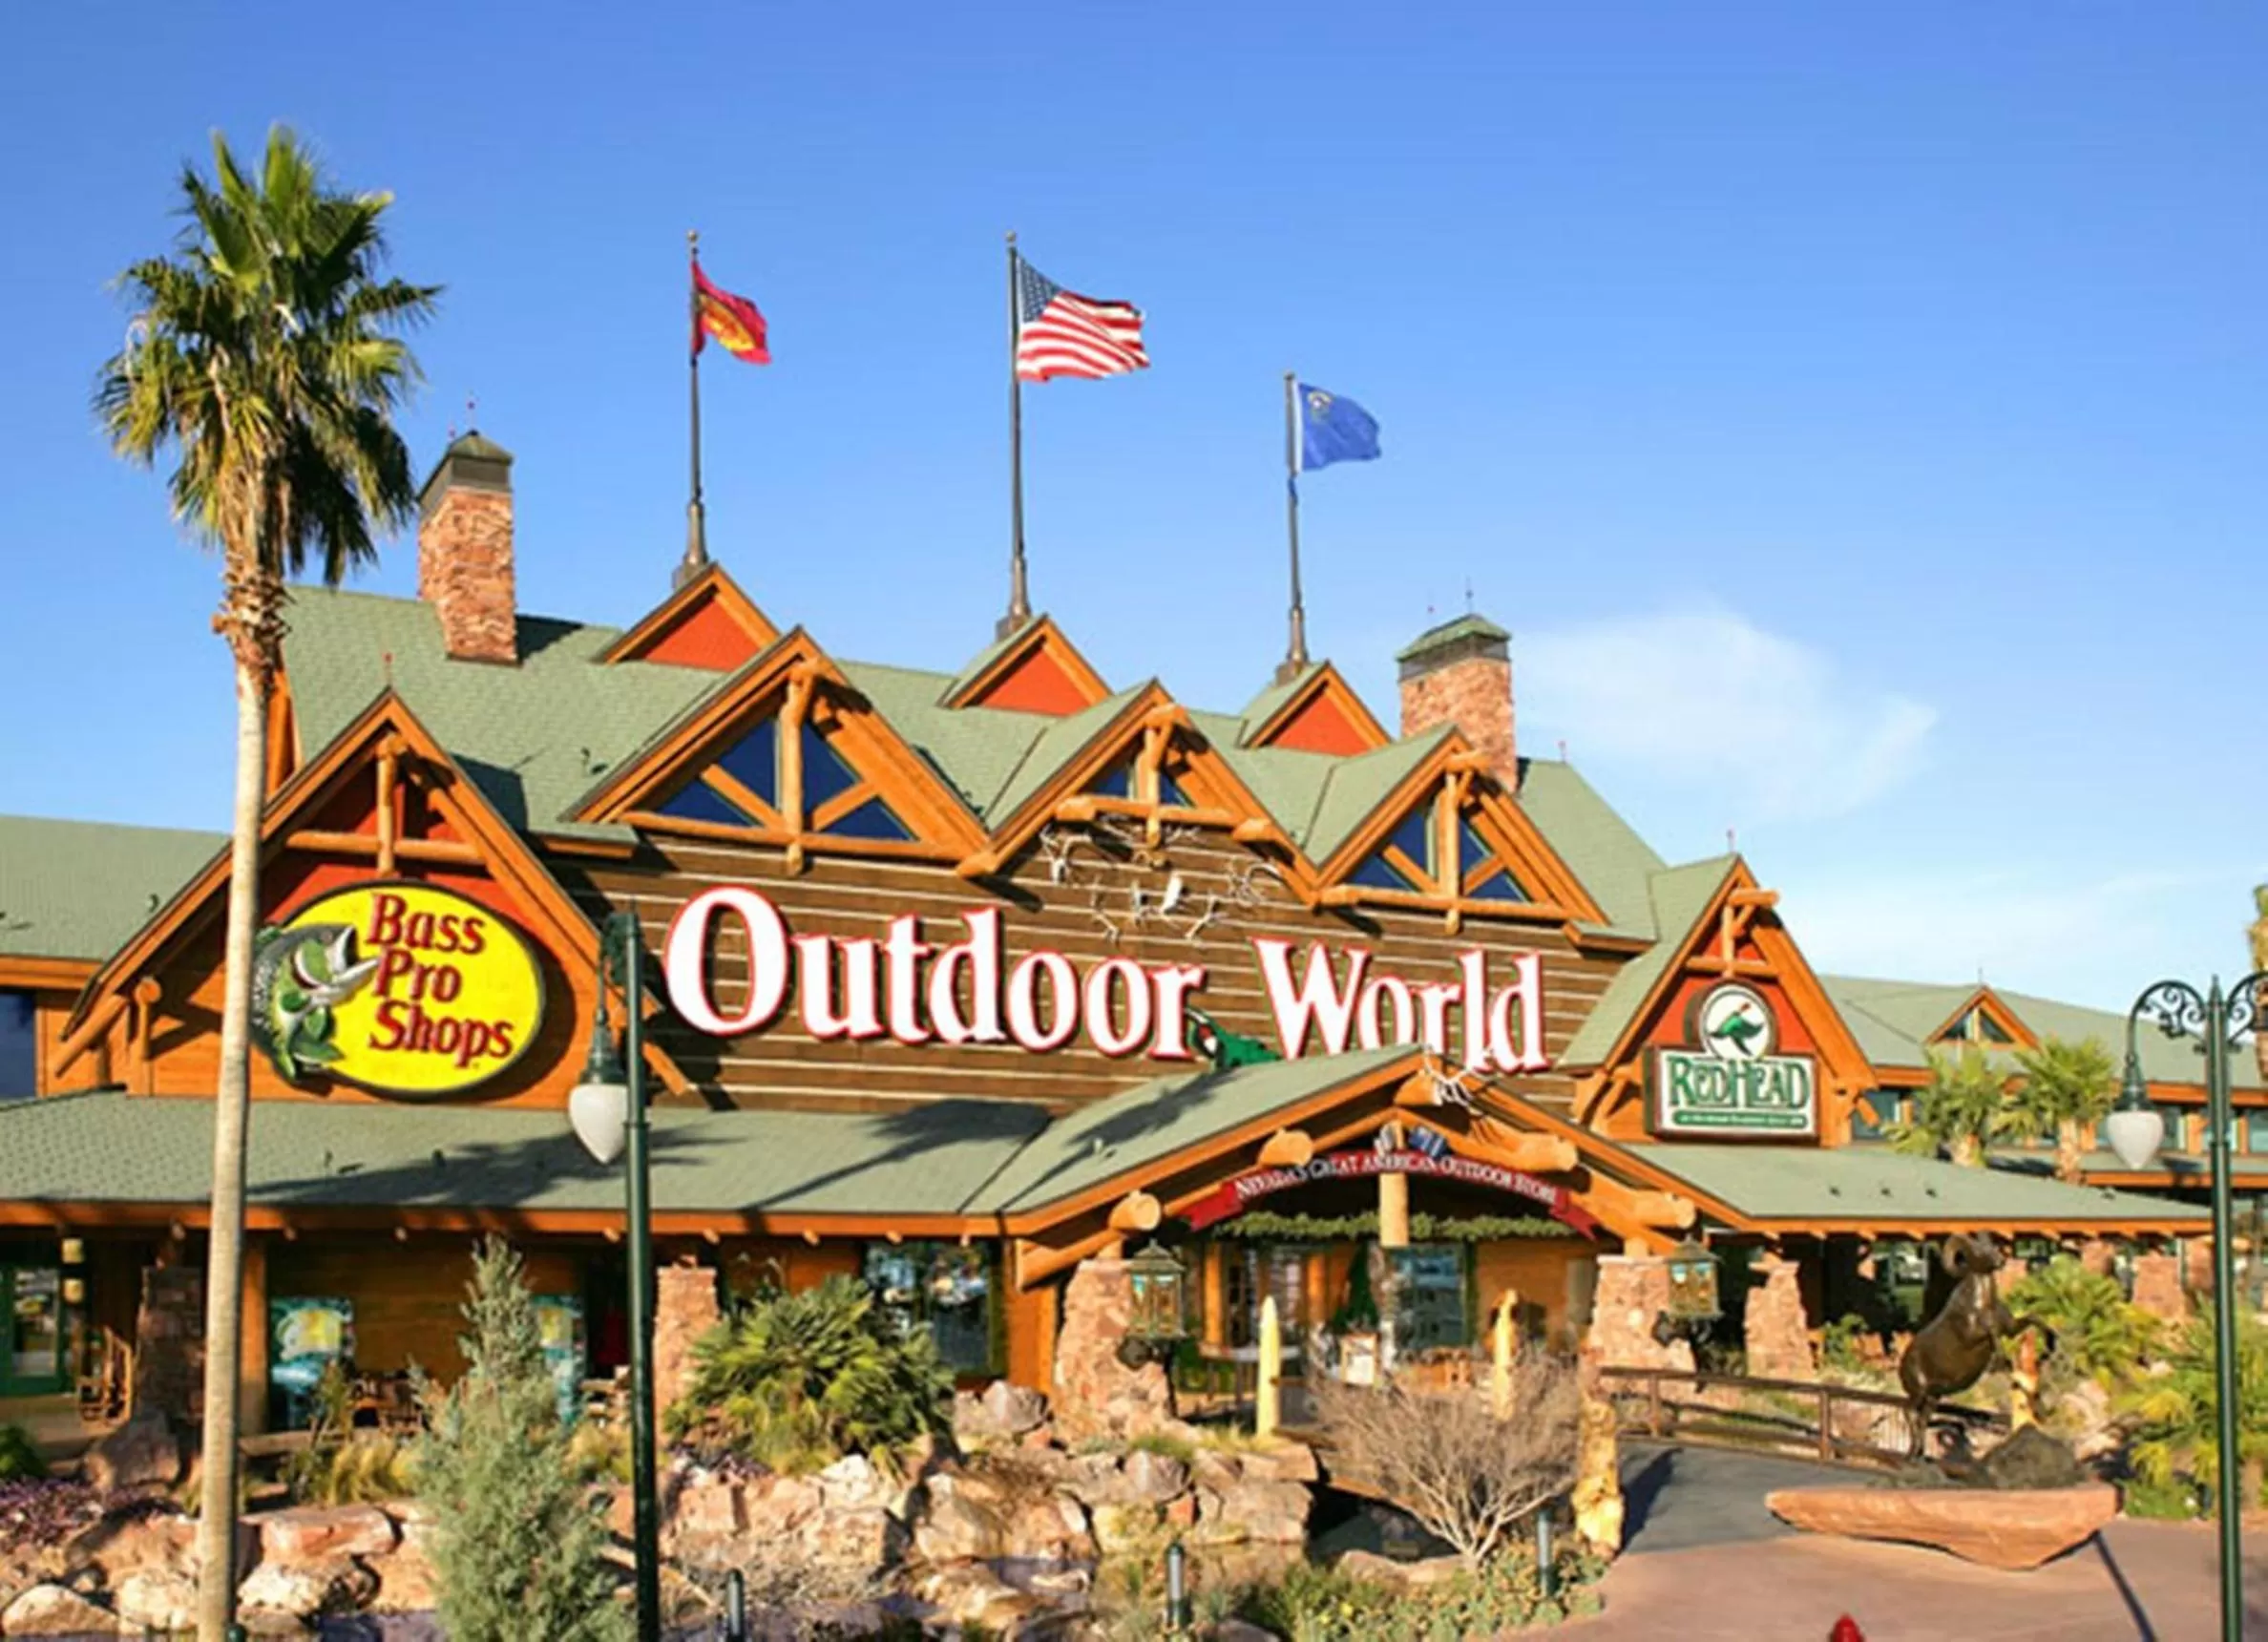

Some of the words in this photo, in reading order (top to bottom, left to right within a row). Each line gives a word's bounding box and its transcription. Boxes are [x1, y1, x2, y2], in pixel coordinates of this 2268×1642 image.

[365, 893, 486, 955] Bass
[371, 947, 462, 1003] Pro
[662, 885, 1207, 1061] Outdoor
[1248, 936, 1550, 1073] World
[368, 999, 514, 1069] Shops
[1309, 1155, 1360, 1180] GREAT
[1439, 1154, 1512, 1189] OUTDOOR
[1513, 1171, 1557, 1206] STORE
